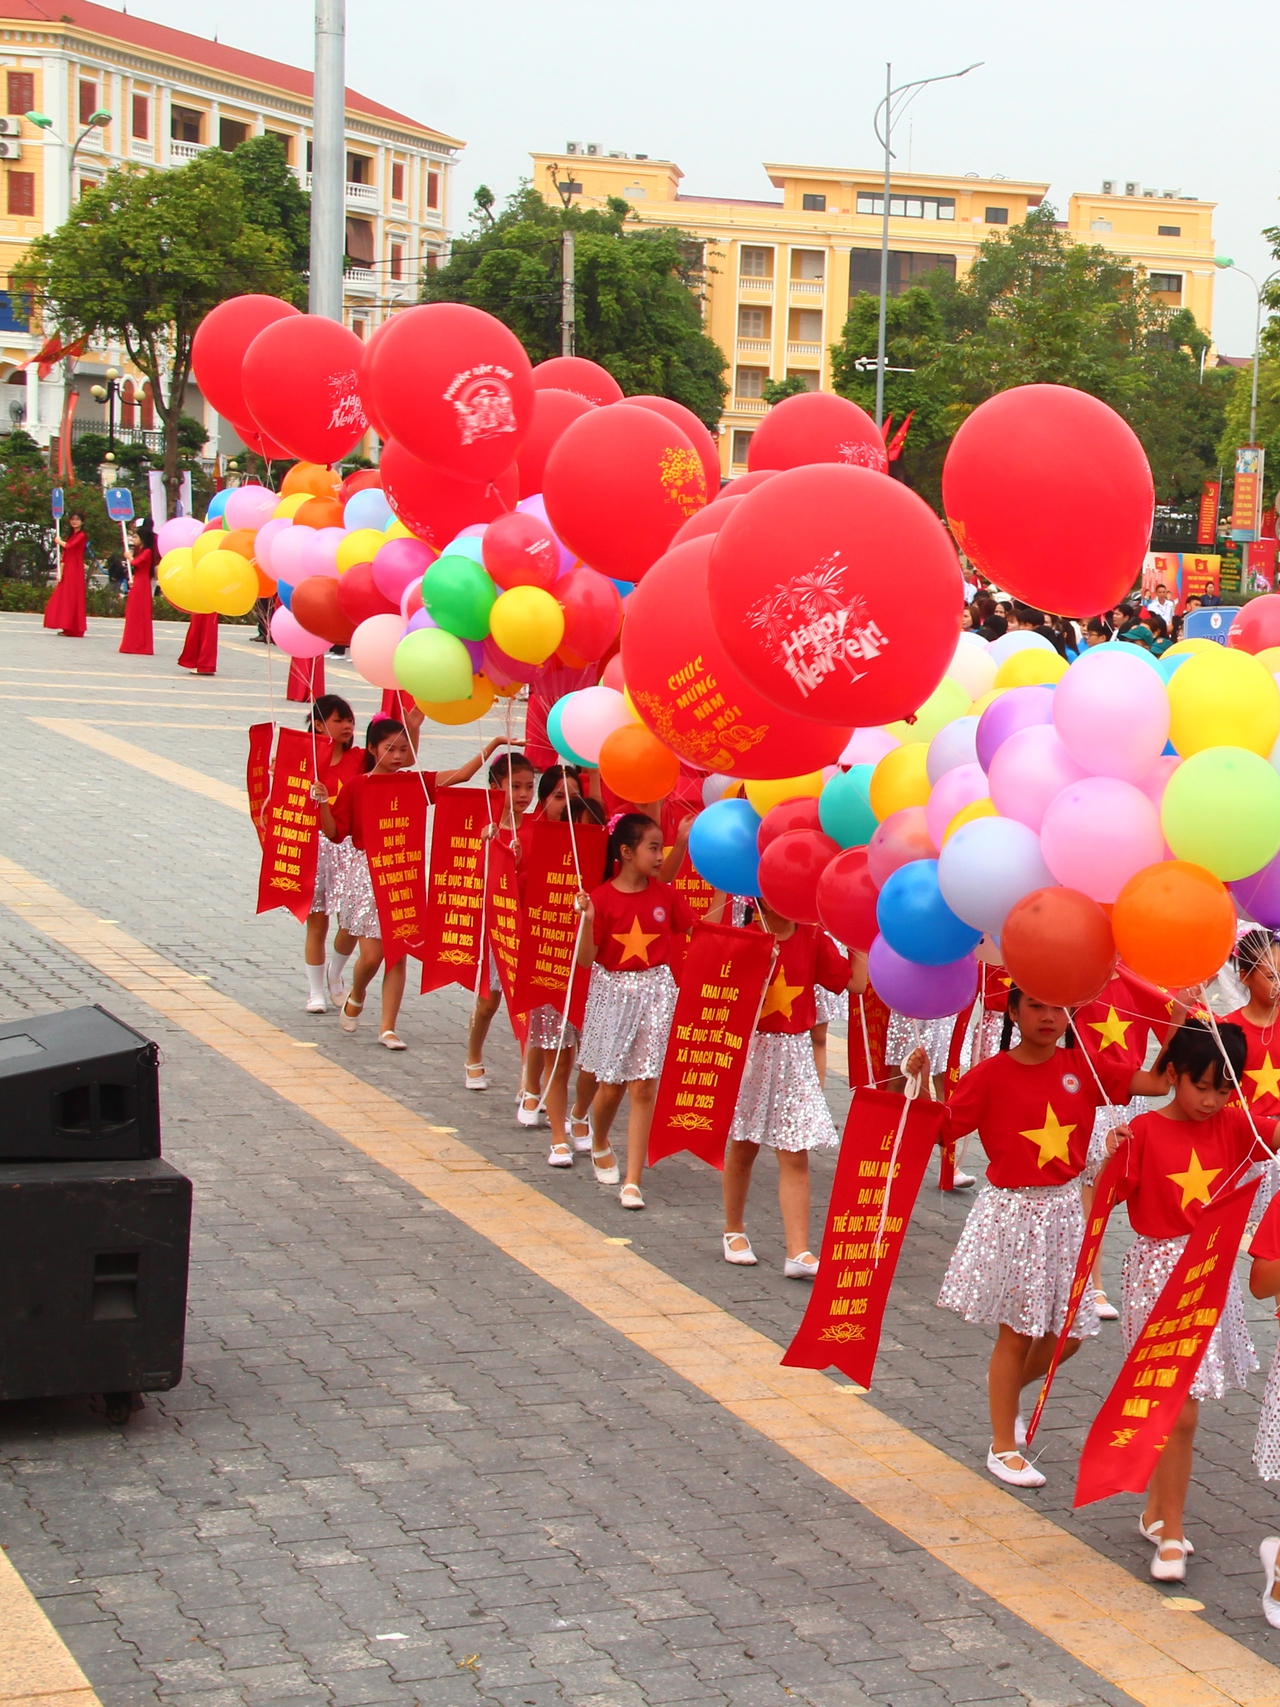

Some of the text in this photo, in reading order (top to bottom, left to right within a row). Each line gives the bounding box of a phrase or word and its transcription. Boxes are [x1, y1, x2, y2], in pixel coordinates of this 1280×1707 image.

[780, 610, 850, 657] Happy
[667, 655, 705, 691] CHÚC
[783, 652, 836, 699] New
[675, 673, 717, 710] MỪNG
[693, 692, 726, 721] NĂM
[712, 705, 743, 731] MỚI
[451, 836, 482, 852] KHAI MẠC
[454, 855, 477, 870] ĐẠI HỘI
[448, 874, 461, 889] DỤC
[547, 871, 564, 885] KHAI
[437, 891, 483, 909] XÃ THẠCH THẤT
[549, 892, 561, 907] ĐẠI
[459, 914, 470, 927] THỨ
[543, 910, 558, 924] DỤC
[442, 931, 473, 946] NĂM 2025
[531, 925, 565, 942] XÃ THẠCH
[554, 946, 568, 960] THỨ
[536, 959, 570, 977] NĂM 2025
[701, 983, 739, 1003] KHAI MẠC
[701, 1007, 729, 1025] ĐẠI HỘI
[692, 1028, 709, 1045] DỤC
[724, 1031, 742, 1050] THAO
[676, 1047, 733, 1069] XÃ THẠCH THẤT
[699, 1072, 715, 1087] THỨ
[714, 1074, 718, 1087] I
[675, 1092, 714, 1109] NĂM 2025
[858, 1161, 901, 1180] KHAI MC
[857, 1185, 887, 1206] ĐẠI HỘ
[848, 1216, 864, 1237] DỤC
[880, 1217, 903, 1233] HAO
[832, 1243, 844, 1261] XÃ
[845, 1244, 869, 1266] THẠCH
[837, 1267, 873, 1289] LẦN THỨ I
[830, 1298, 868, 1316] NĂM 2025
